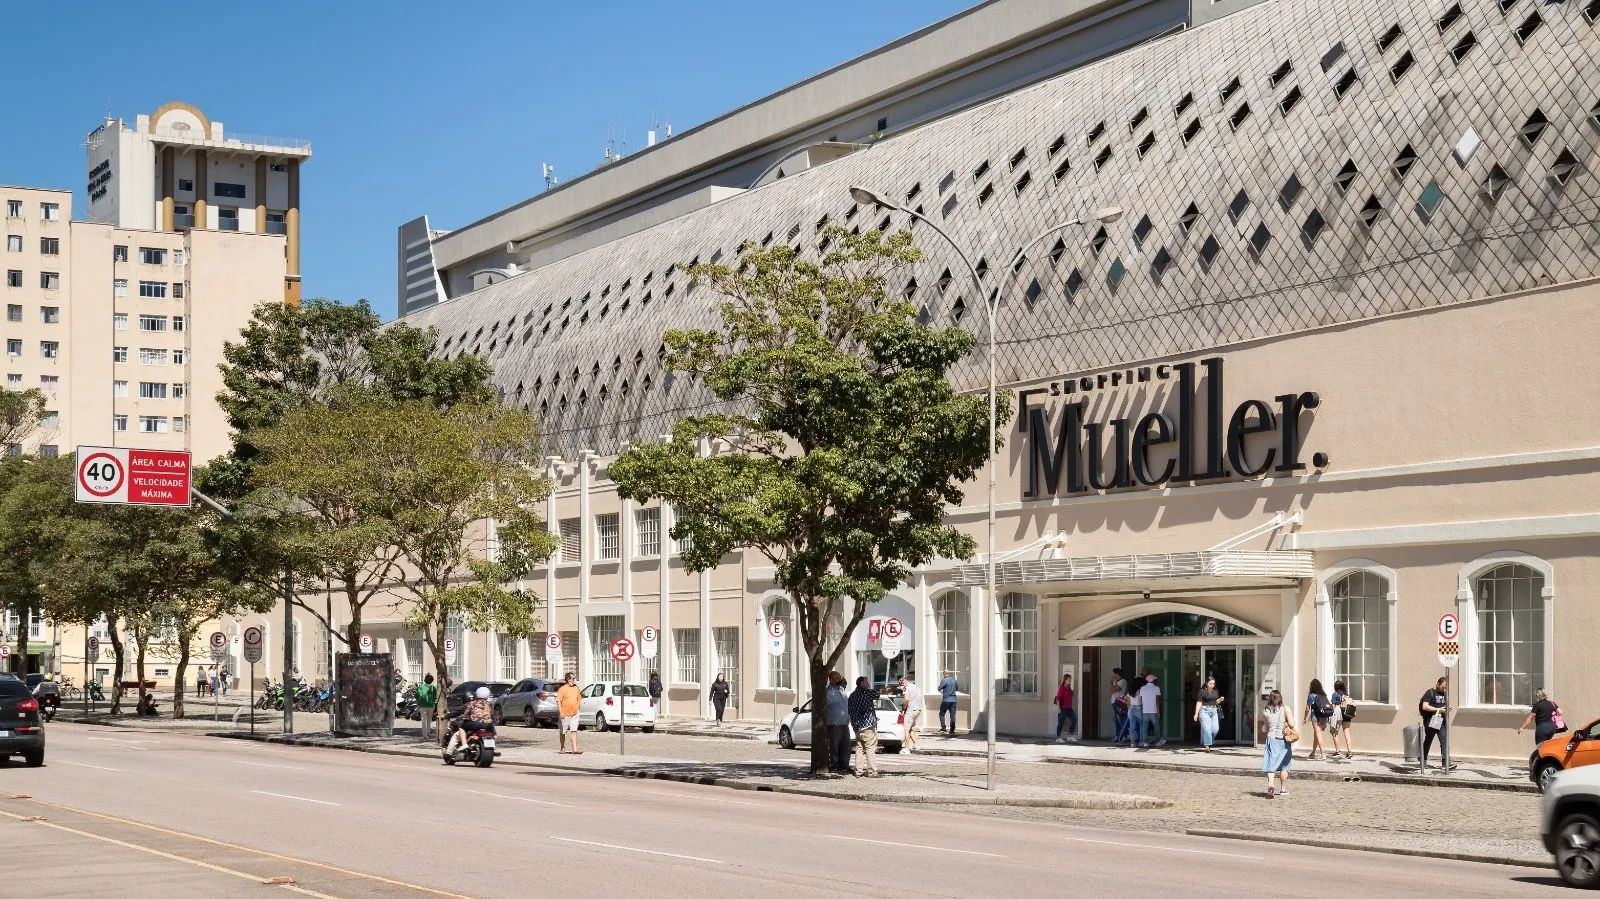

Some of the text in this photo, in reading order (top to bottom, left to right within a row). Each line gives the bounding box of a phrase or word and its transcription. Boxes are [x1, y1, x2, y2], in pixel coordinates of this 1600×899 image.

[1050, 364, 1171, 396] SHOPPING
[131, 456, 186, 468] ÁREA CALMA
[87, 462, 115, 482] 40
[133, 477, 184, 488] VELOCIDADE
[141, 488, 173, 499] MÁXIMA
[774, 623, 780, 634] E
[1445, 619, 1453, 634] E
[215, 635, 222, 644] E
[646, 629, 652, 639] E
[90, 639, 96, 647] E
[363, 637, 369, 646] E
[446, 640, 452, 649] E
[550, 636, 557, 646] E
